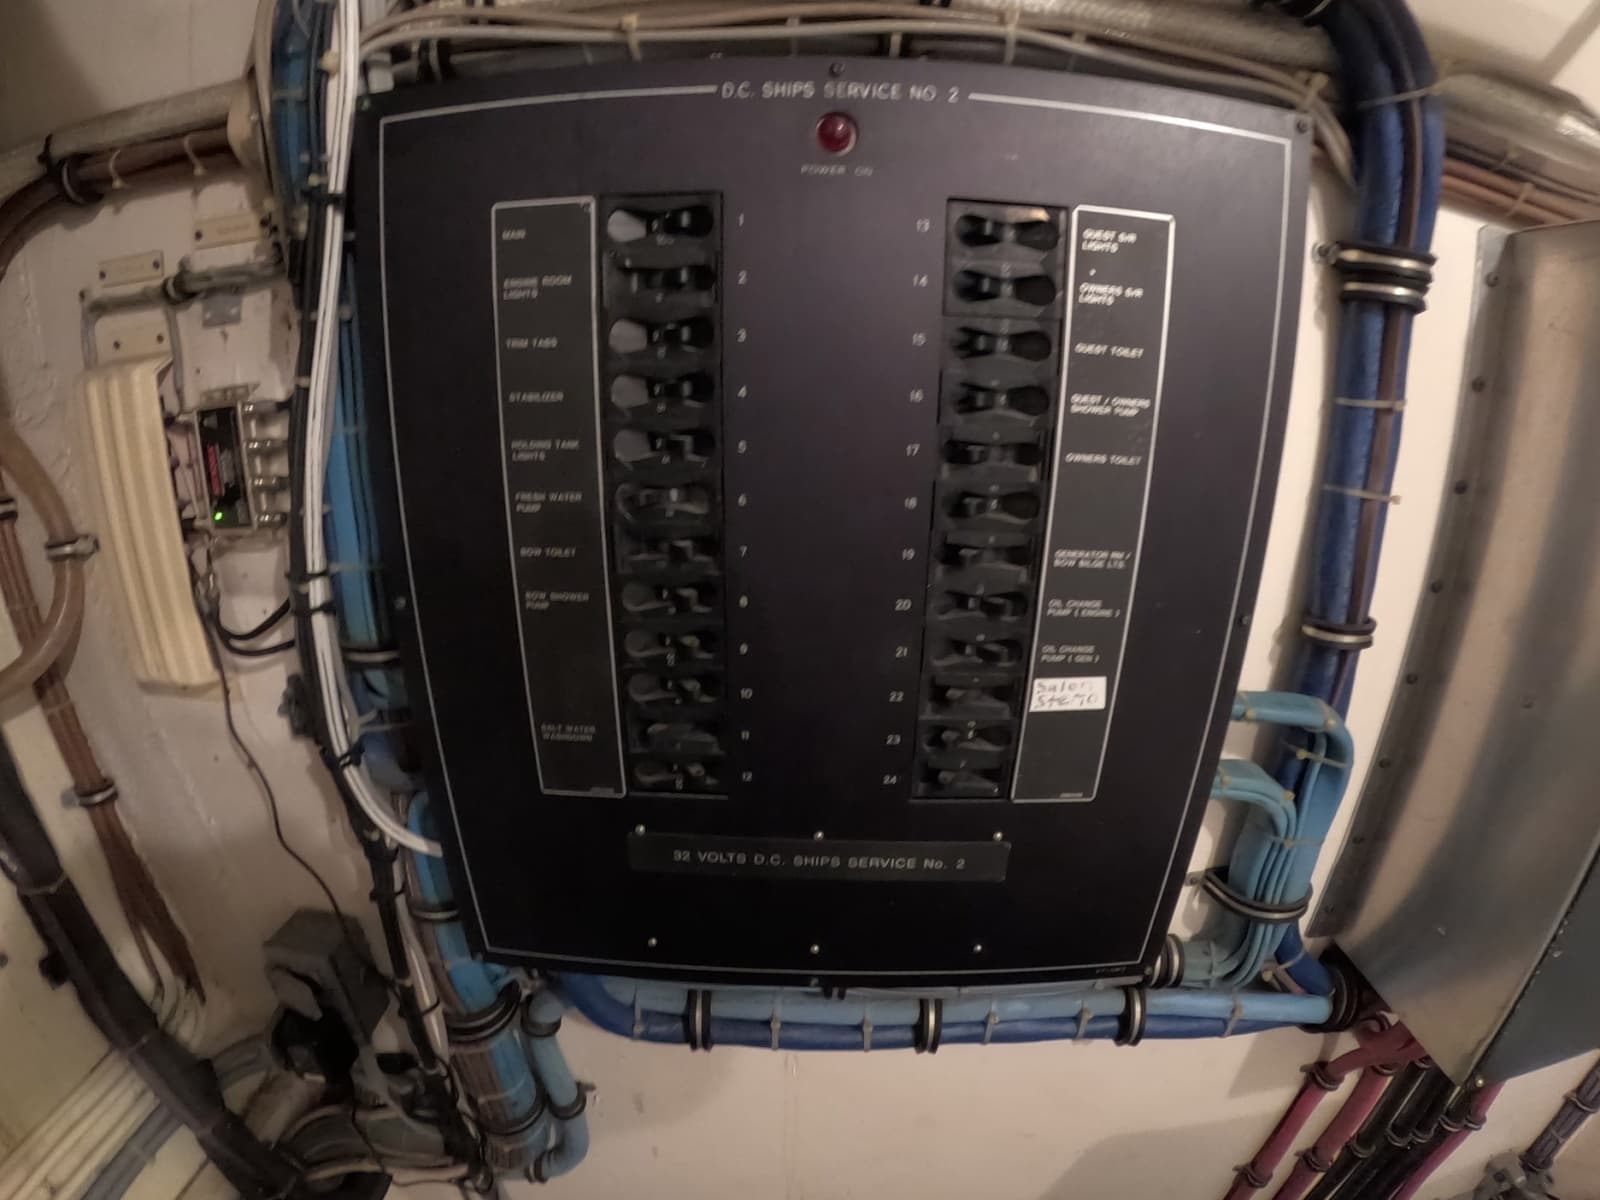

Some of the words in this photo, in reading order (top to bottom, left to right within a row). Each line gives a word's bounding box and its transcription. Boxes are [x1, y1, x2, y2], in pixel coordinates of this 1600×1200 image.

[761, 80, 815, 99] SHIPS
[823, 81, 901, 100] SERVICE
[948, 86, 960, 102] 2
[801, 164, 846, 175] POWER
[698, 852, 747, 865] VOLTS
[753, 853, 785, 866] D.C.
[793, 854, 841, 868] SHIPS
[847, 856, 917, 870] SERVICE
[955, 858, 966, 870] 2
